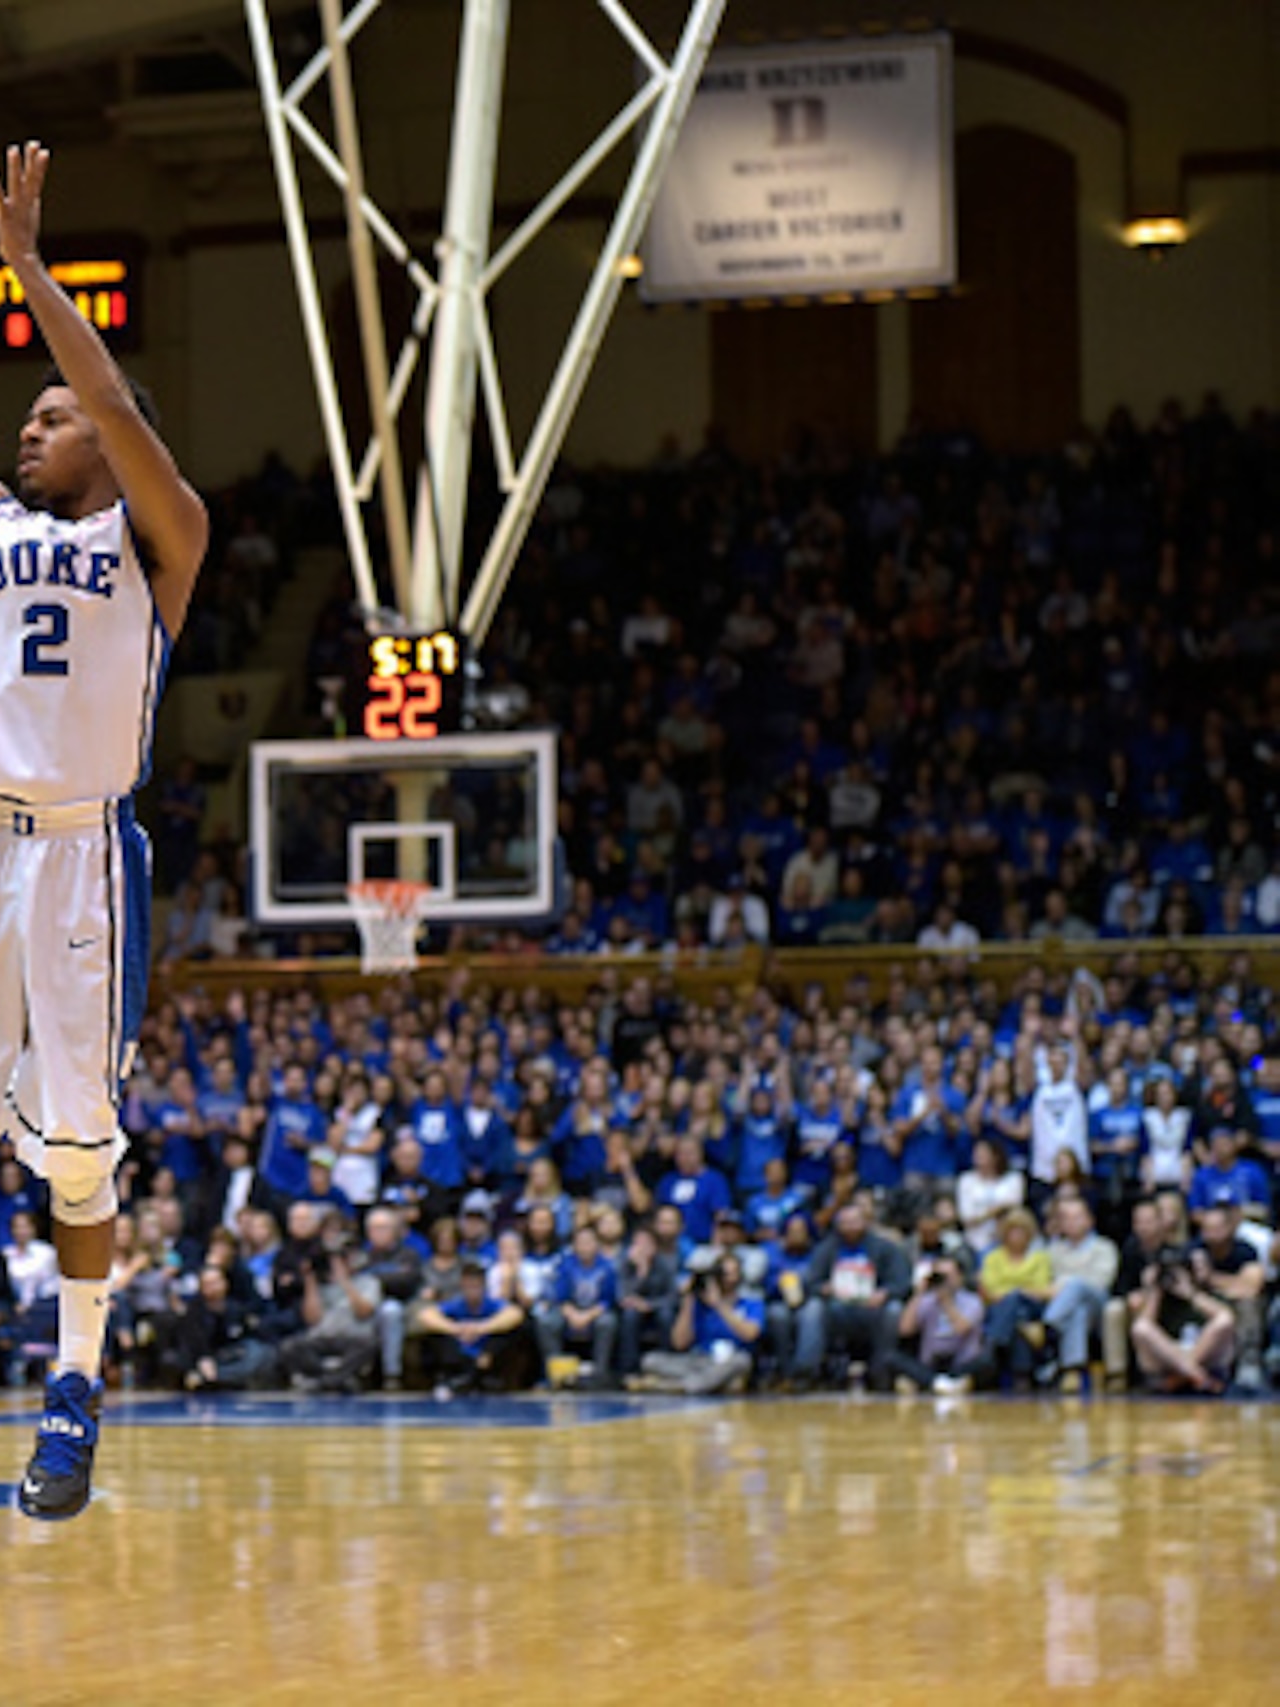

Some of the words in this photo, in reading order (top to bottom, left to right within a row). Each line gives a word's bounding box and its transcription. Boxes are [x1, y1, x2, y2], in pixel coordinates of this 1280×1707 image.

[22, 604, 68, 676] 2
[370, 632, 458, 678] 5:17
[363, 672, 441, 740] 22
